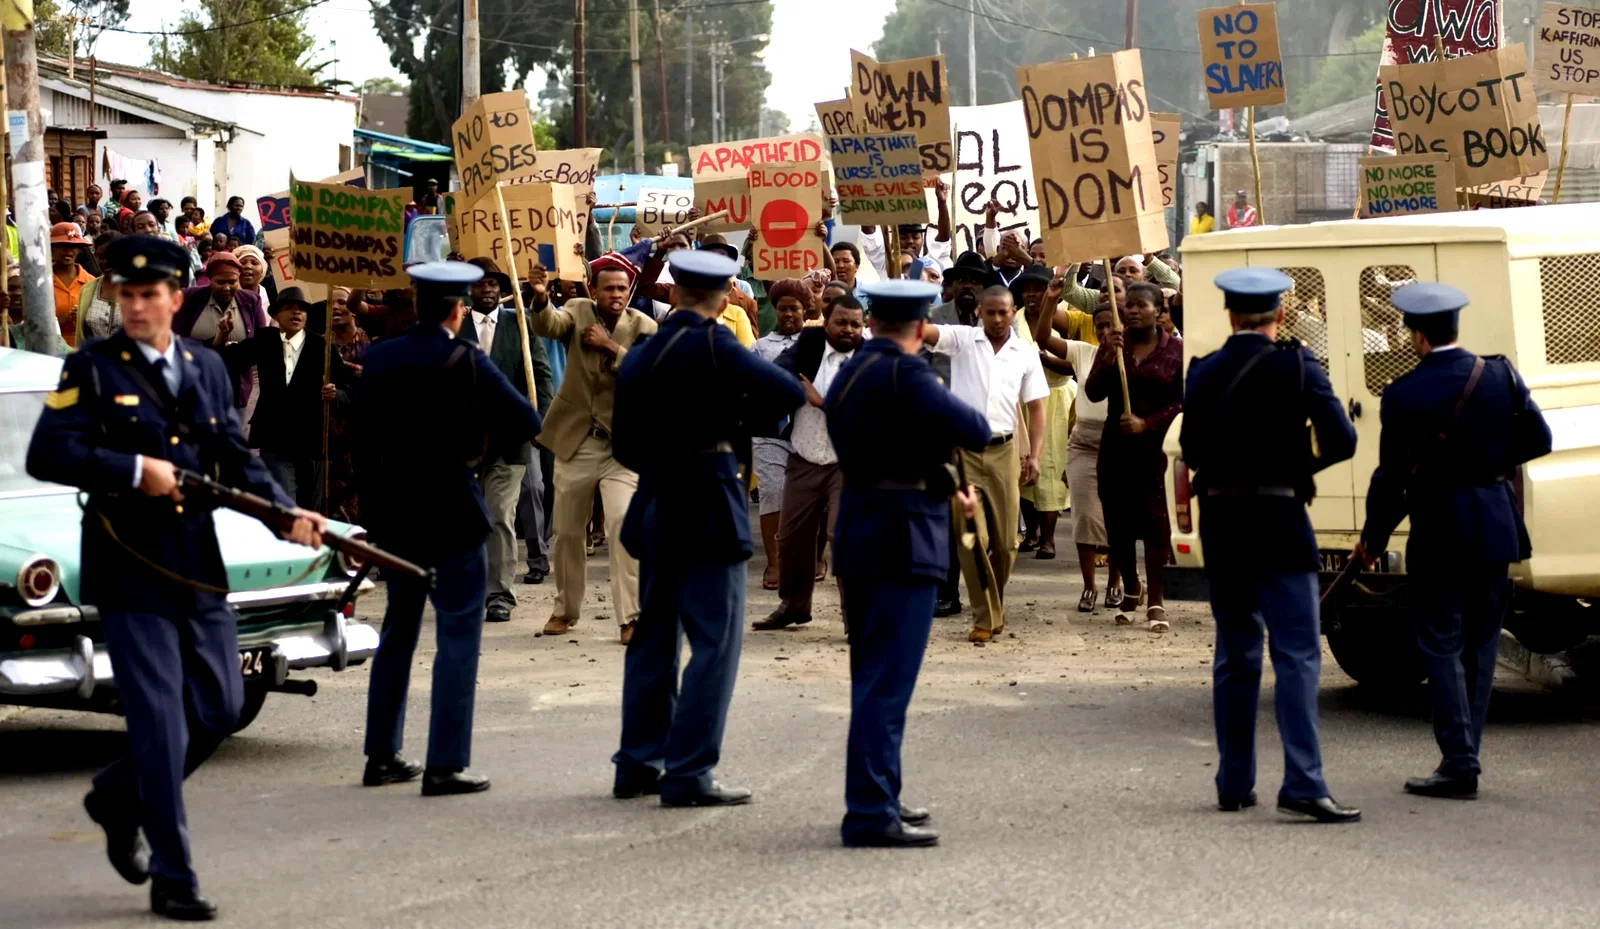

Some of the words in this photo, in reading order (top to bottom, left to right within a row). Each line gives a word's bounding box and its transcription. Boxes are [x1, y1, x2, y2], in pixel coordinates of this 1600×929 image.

[1213, 10, 1258, 36] NO
[1216, 39, 1257, 59] TO
[1541, 28, 1600, 47] KAFFIRIN
[1561, 48, 1583, 65] US
[857, 60, 942, 106] DOWN
[1206, 61, 1284, 95] SLAVERY
[1550, 63, 1599, 83] STOP
[865, 101, 926, 131] with
[1021, 79, 1145, 139] DOMPAS
[458, 115, 484, 158] NO
[490, 111, 518, 128] to
[830, 135, 917, 154] APARTHATE
[1070, 128, 1110, 163] IS
[1463, 123, 1547, 168] BOOK
[697, 140, 821, 174] APARTHEID
[869, 153, 884, 166] IS
[462, 144, 537, 197] PASSES
[751, 171, 818, 188] BLOOD
[1365, 166, 1384, 182] NO
[1388, 164, 1437, 180] MORE
[320, 188, 404, 214] DOMPAS
[837, 184, 871, 197] EVIL
[874, 181, 922, 196] EVILS
[1042, 165, 1146, 230] DOM
[1367, 185, 1389, 200] NO
[1391, 182, 1437, 195] MORE
[1368, 200, 1393, 214] NO
[1395, 196, 1438, 211] MORE
[316, 207, 402, 232] DOMPAS
[315, 255, 397, 277] DOMPAS
[758, 249, 818, 272] SHED
